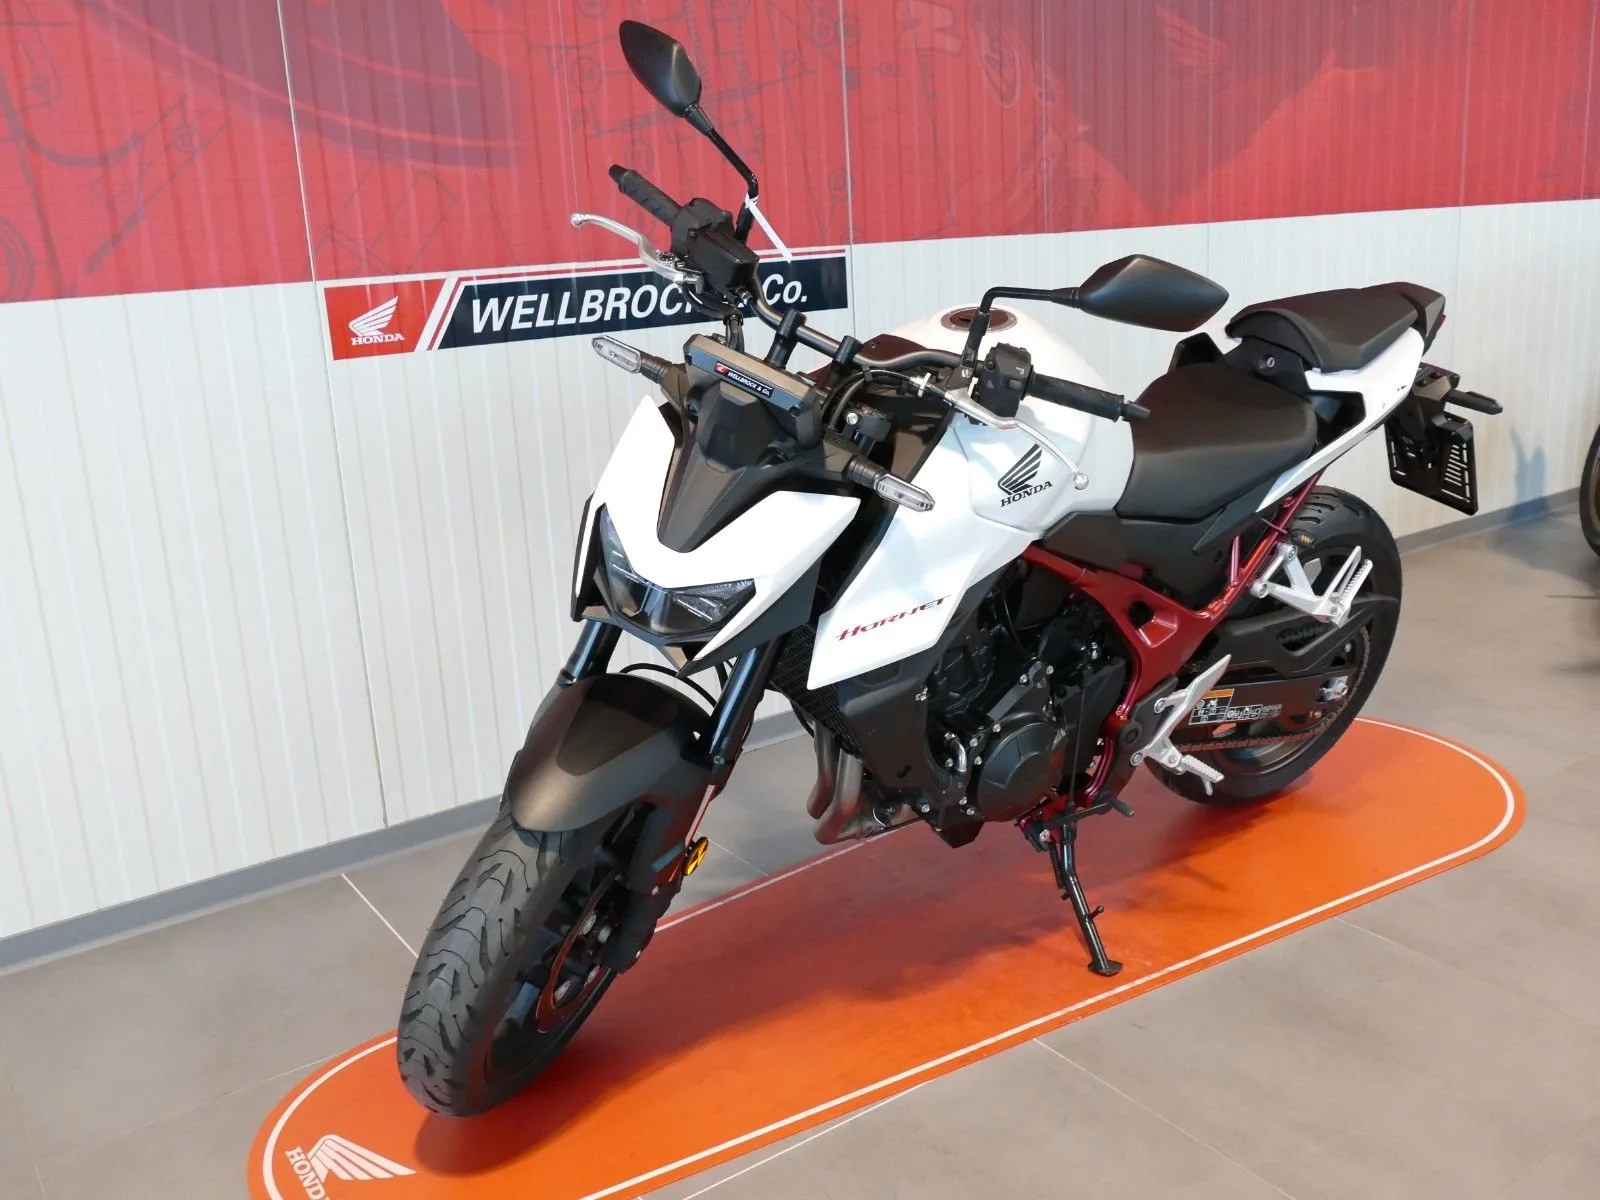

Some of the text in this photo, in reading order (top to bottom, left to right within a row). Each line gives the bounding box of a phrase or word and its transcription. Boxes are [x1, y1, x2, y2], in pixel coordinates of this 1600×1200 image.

[762, 273, 808, 307] Co.
[350, 333, 405, 346] HONDA
[728, 371, 756, 389] WELLBROCK
[1000, 480, 1053, 508] HONDA
[835, 595, 951, 641] HORNET
[284, 1146, 331, 1200] HOND
